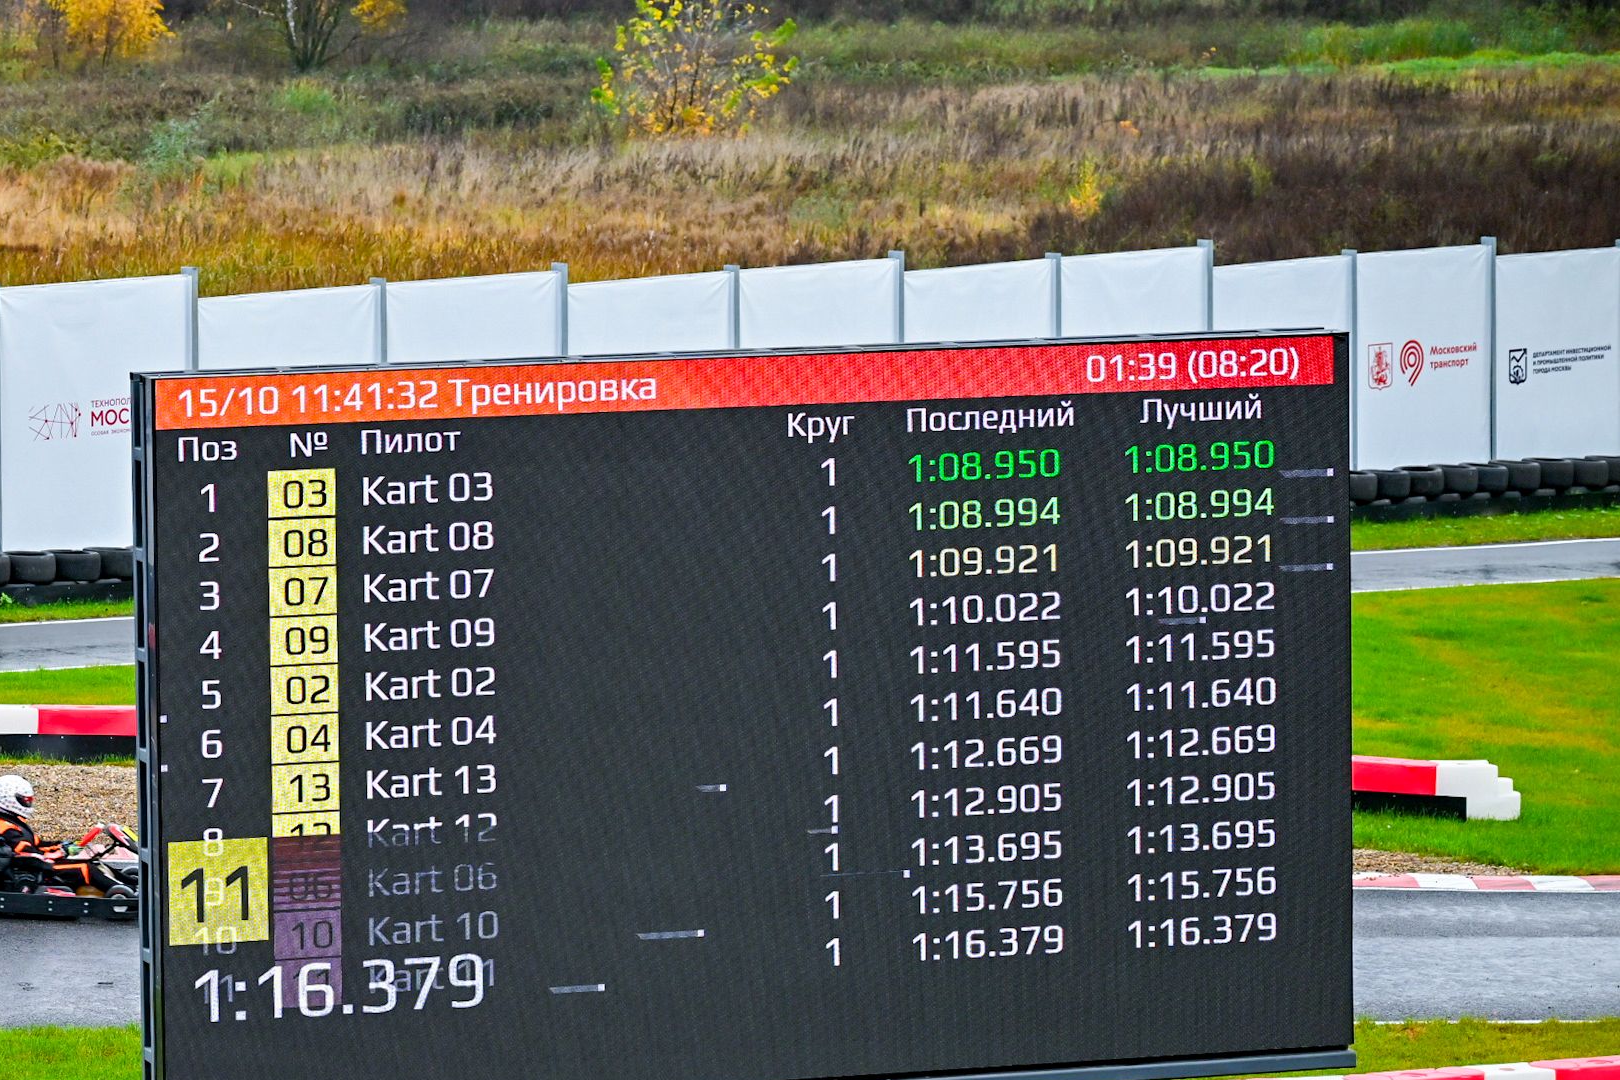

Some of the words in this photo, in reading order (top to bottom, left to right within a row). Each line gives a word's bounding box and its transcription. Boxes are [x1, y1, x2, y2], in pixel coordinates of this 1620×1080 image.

[1087, 352, 1176, 382] 01:39
[1188, 347, 1299, 383] (08:20)
[1430, 342, 1477, 355] Московский
[1430, 359, 1468, 371] транспорт
[179, 386, 278, 417] 15/10
[292, 380, 438, 413] 11:41:32
[448, 378, 656, 414] Тренировка
[788, 413, 854, 443] Круг
[906, 400, 1073, 434] Последний
[1140, 393, 1261, 429] Лучший
[178, 437, 237, 462] Поз
[290, 432, 328, 457] №
[361, 430, 461, 454] Пилот
[201, 484, 215, 512] 1
[284, 480, 326, 508] 03
[363, 475, 438, 506] Kart
[449, 472, 492, 501] 03
[821, 458, 835, 486] 1
[909, 449, 1060, 482] 1:08.950
[1125, 440, 1274, 473] 1:08.950
[199, 533, 219, 562] 2
[284, 529, 327, 557] 08
[363, 523, 439, 554] Kart
[449, 521, 493, 551] 08
[822, 506, 835, 534] 1
[909, 497, 1060, 530] 1:08.994
[1126, 488, 1274, 521] 1:08.994
[200, 582, 219, 610] 3
[285, 577, 328, 606] 07
[364, 572, 439, 602] Kart
[450, 569, 494, 598] 07
[822, 554, 835, 581] 1
[909, 544, 1056, 577] 1:09.921
[1126, 535, 1270, 568] 1:09.921
[200, 631, 221, 659] 4
[286, 626, 328, 655] 09
[365, 621, 440, 652] Kart
[450, 618, 494, 647] 09
[823, 602, 836, 630] 1
[910, 592, 1060, 625] 1:10.022
[1126, 582, 1274, 617] 1:10.022
[202, 680, 221, 709] 5
[287, 675, 329, 704] 02
[365, 669, 441, 701] Kart
[452, 667, 495, 696] 02
[823, 650, 837, 678] 1
[910, 640, 1060, 674] 1:11.595
[1126, 629, 1274, 663] 1:11.595
[202, 730, 222, 758] 6
[287, 725, 330, 753] 04
[366, 719, 441, 750] Kart
[452, 715, 496, 745] 04
[824, 698, 837, 726] 1
[911, 688, 1061, 722] 1:11.640
[1127, 677, 1276, 711] 1:11.640
[202, 778, 223, 807] 7
[290, 774, 330, 802] 13
[367, 767, 442, 799] Kart
[455, 765, 496, 794] 13
[824, 747, 838, 774] 1
[911, 735, 1061, 770] 1:12.669
[1127, 724, 1275, 758] 1:12.669
[201, 828, 223, 857] 8
[366, 818, 443, 850] Kart
[455, 813, 497, 843] 12
[825, 795, 838, 823] 1
[911, 783, 1061, 818] 1:12.905
[1127, 772, 1275, 806] 1:12.905
[181, 865, 249, 923] 11
[366, 868, 444, 898] Kart
[452, 862, 497, 892] 06
[825, 843, 838, 871] 1
[912, 831, 1061, 866] 1:13.695
[1127, 819, 1275, 854] 1:13.695
[292, 919, 334, 951] 10
[367, 916, 444, 947] Kart
[458, 910, 499, 940] 10
[825, 891, 839, 919] 1
[912, 878, 1062, 914] 1:15.756
[1128, 867, 1276, 901] 1:15.756
[826, 938, 840, 966] 1
[913, 925, 1063, 961] 1:16.379
[1128, 913, 1276, 948] 1:16.379
[195, 953, 485, 1023] 1:16.379
